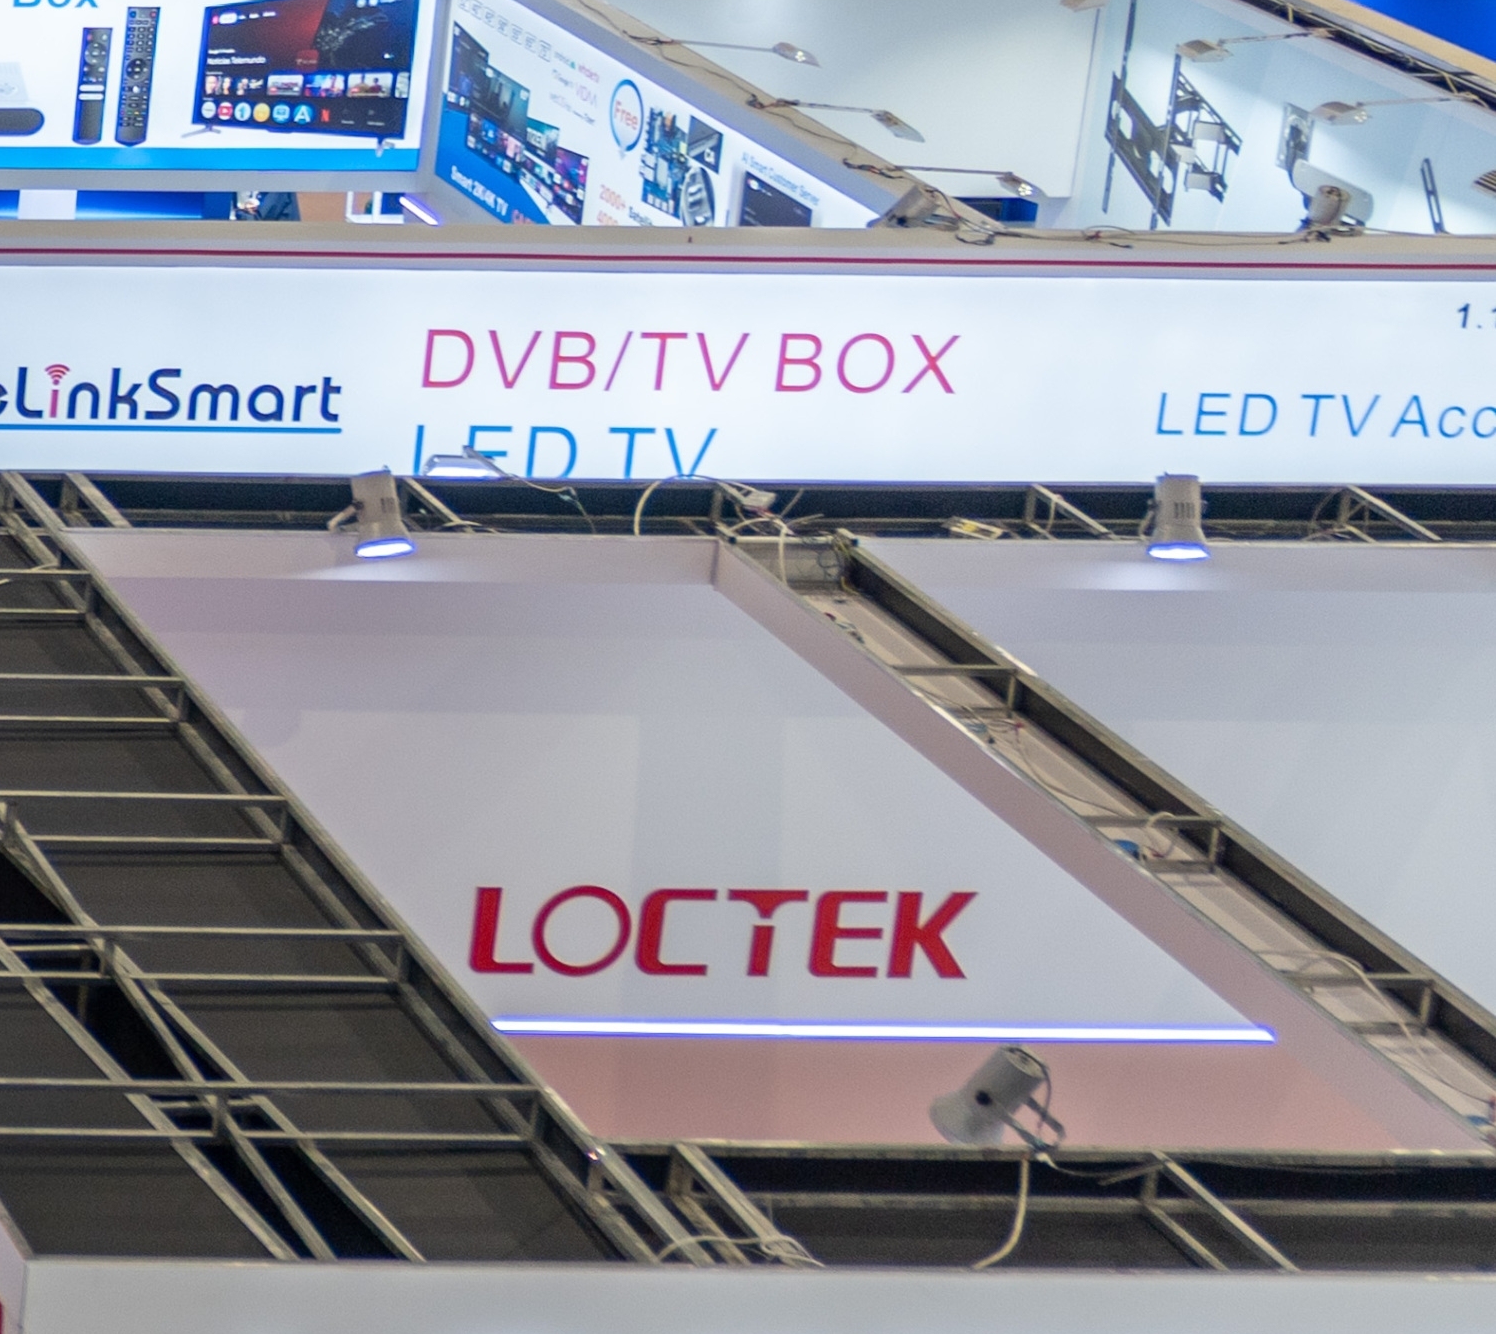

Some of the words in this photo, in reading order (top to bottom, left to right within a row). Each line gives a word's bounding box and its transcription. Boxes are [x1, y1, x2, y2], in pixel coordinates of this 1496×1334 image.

[614, 101, 640, 131] Free
[450, 165, 473, 195] Smart
[494, 192, 509, 217] TV
[599, 183, 627, 211] 2000+
[420, 327, 751, 392] DVB/TV
[775, 332, 963, 396] BOX
[1155, 392, 1279, 439] LED
[1300, 394, 1380, 439] TV
[412, 424, 578, 479] LED
[607, 426, 719, 479] TV
[466, 884, 980, 981] LOCTEK
